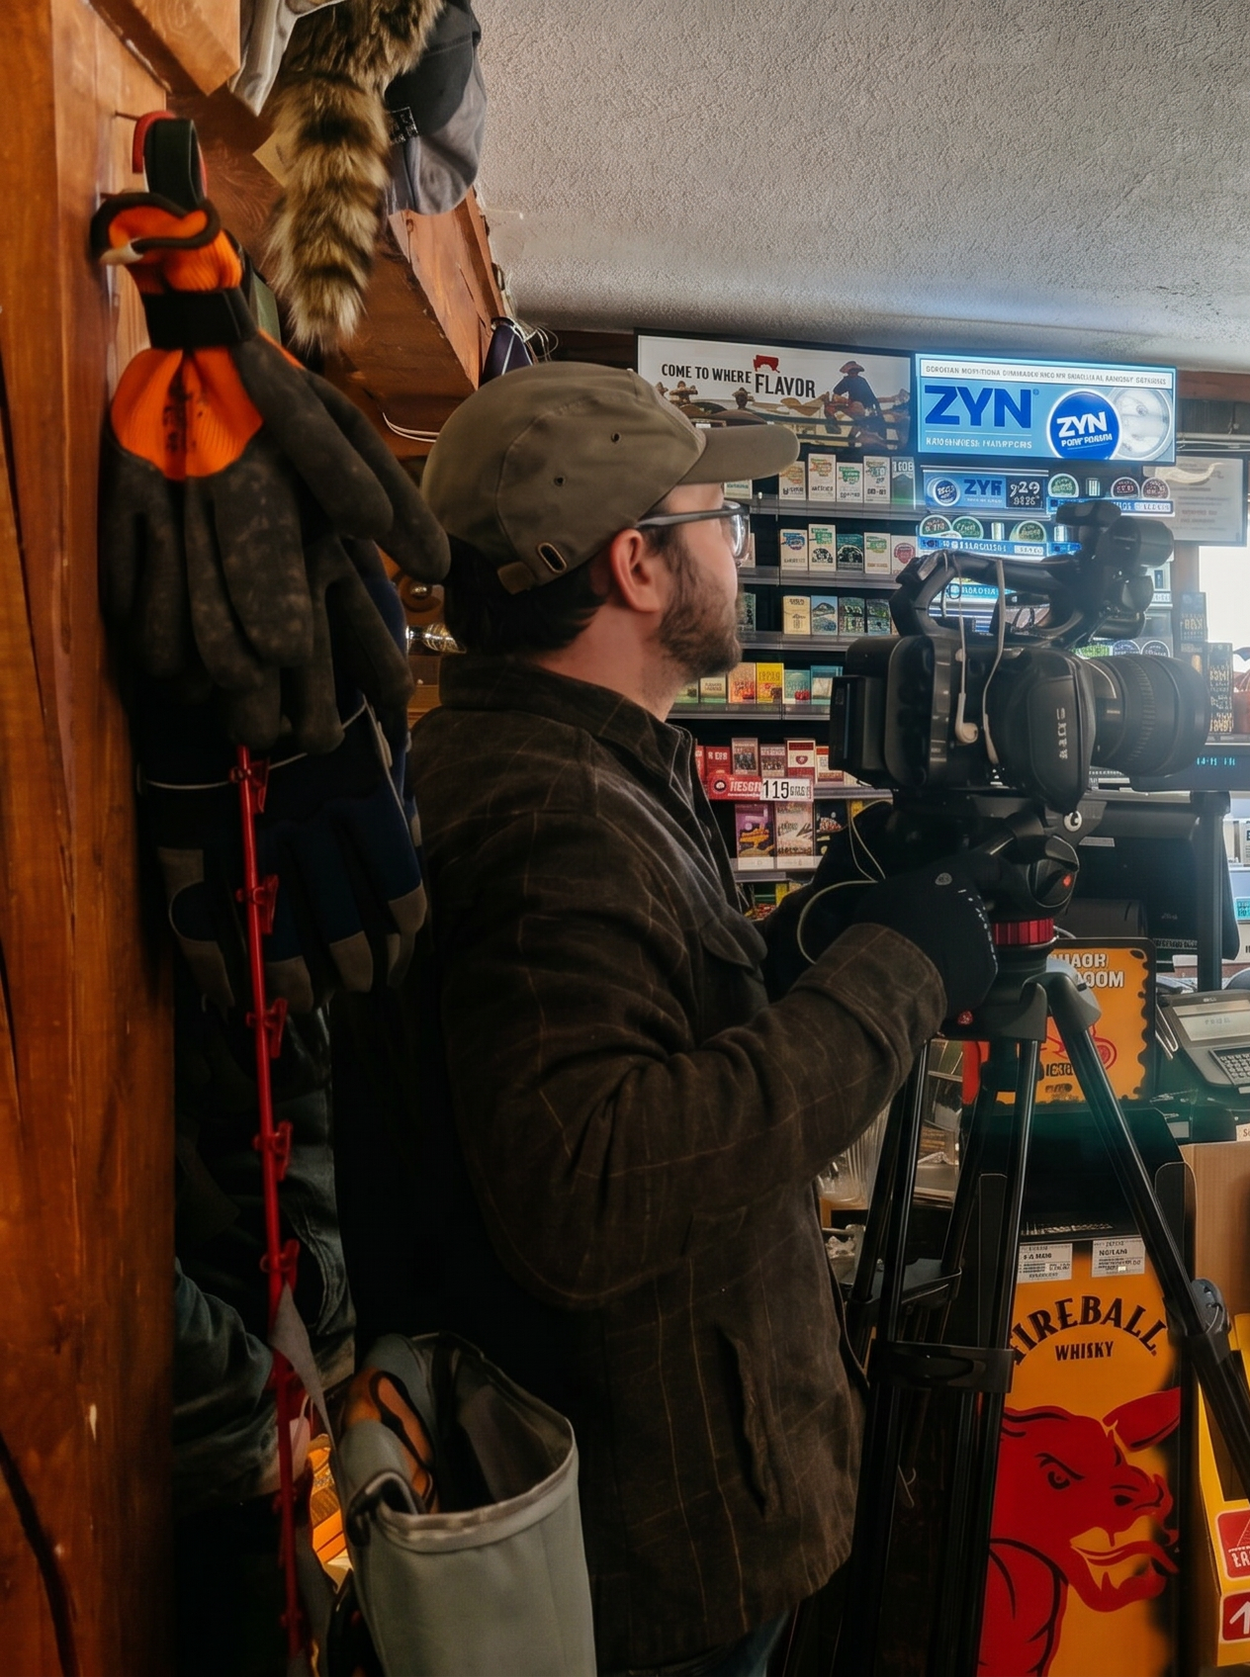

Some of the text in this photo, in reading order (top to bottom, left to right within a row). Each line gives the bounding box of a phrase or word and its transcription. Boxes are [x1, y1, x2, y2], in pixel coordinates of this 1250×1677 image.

[661, 363, 816, 399] COME TO WHERE FLAVOR
[924, 384, 1032, 429] ZYN
[1056, 411, 1108, 438] ZYN
[1055, 1341, 1114, 1362] WHISKY
